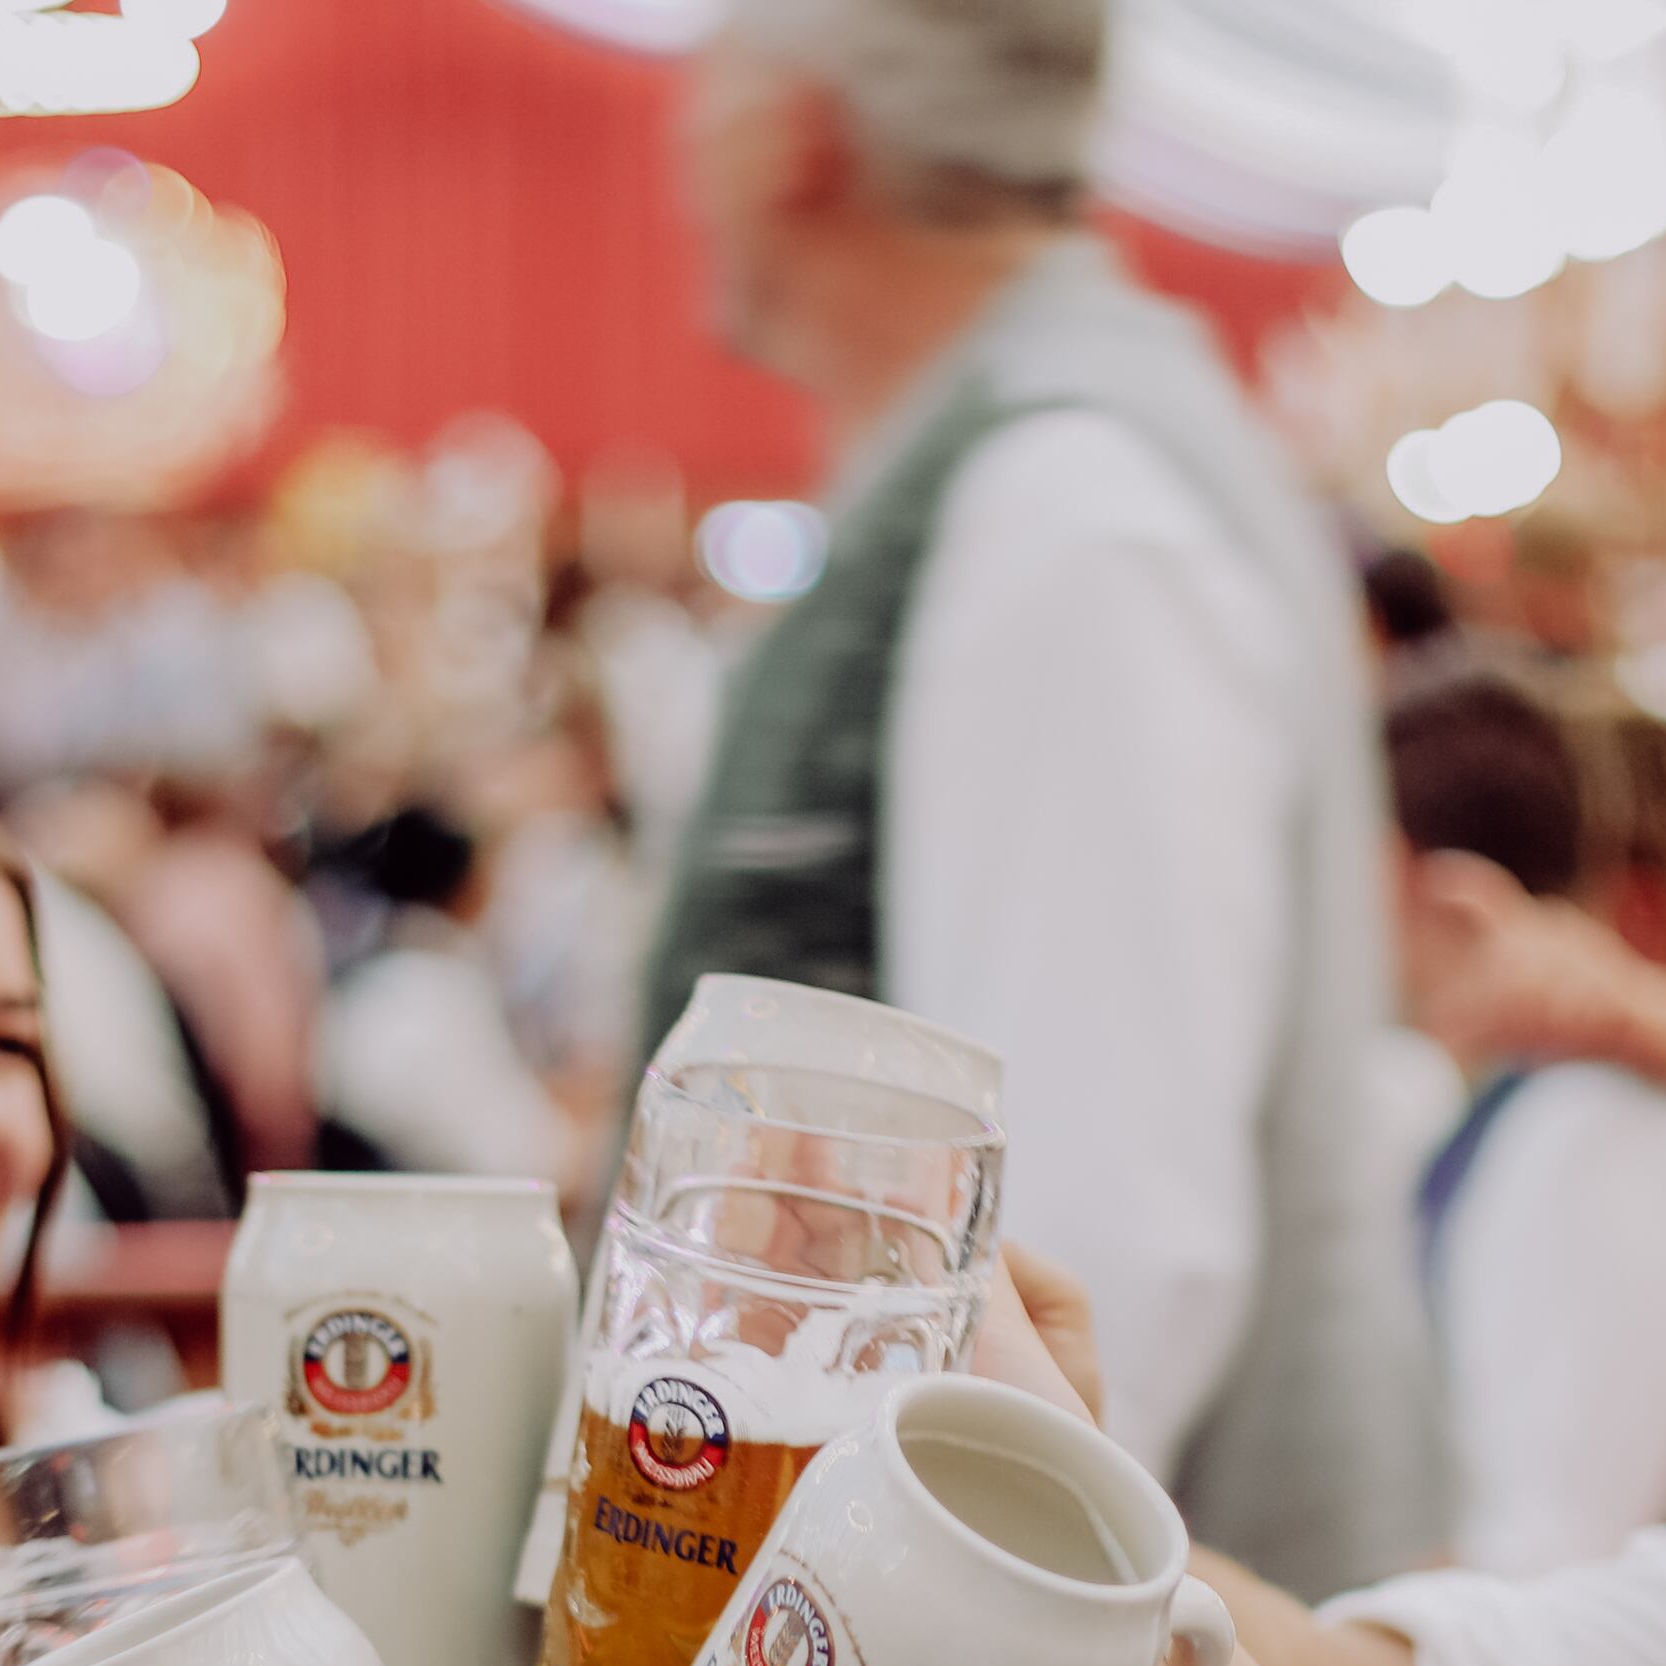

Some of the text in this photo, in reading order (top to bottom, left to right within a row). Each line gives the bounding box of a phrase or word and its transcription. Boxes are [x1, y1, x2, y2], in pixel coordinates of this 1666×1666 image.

[308, 1311, 407, 1356] ERDINGER
[633, 1378, 725, 1438] ERDINGER
[292, 1446, 443, 1484] RDINGER
[592, 1495, 739, 1575] ERDINGER
